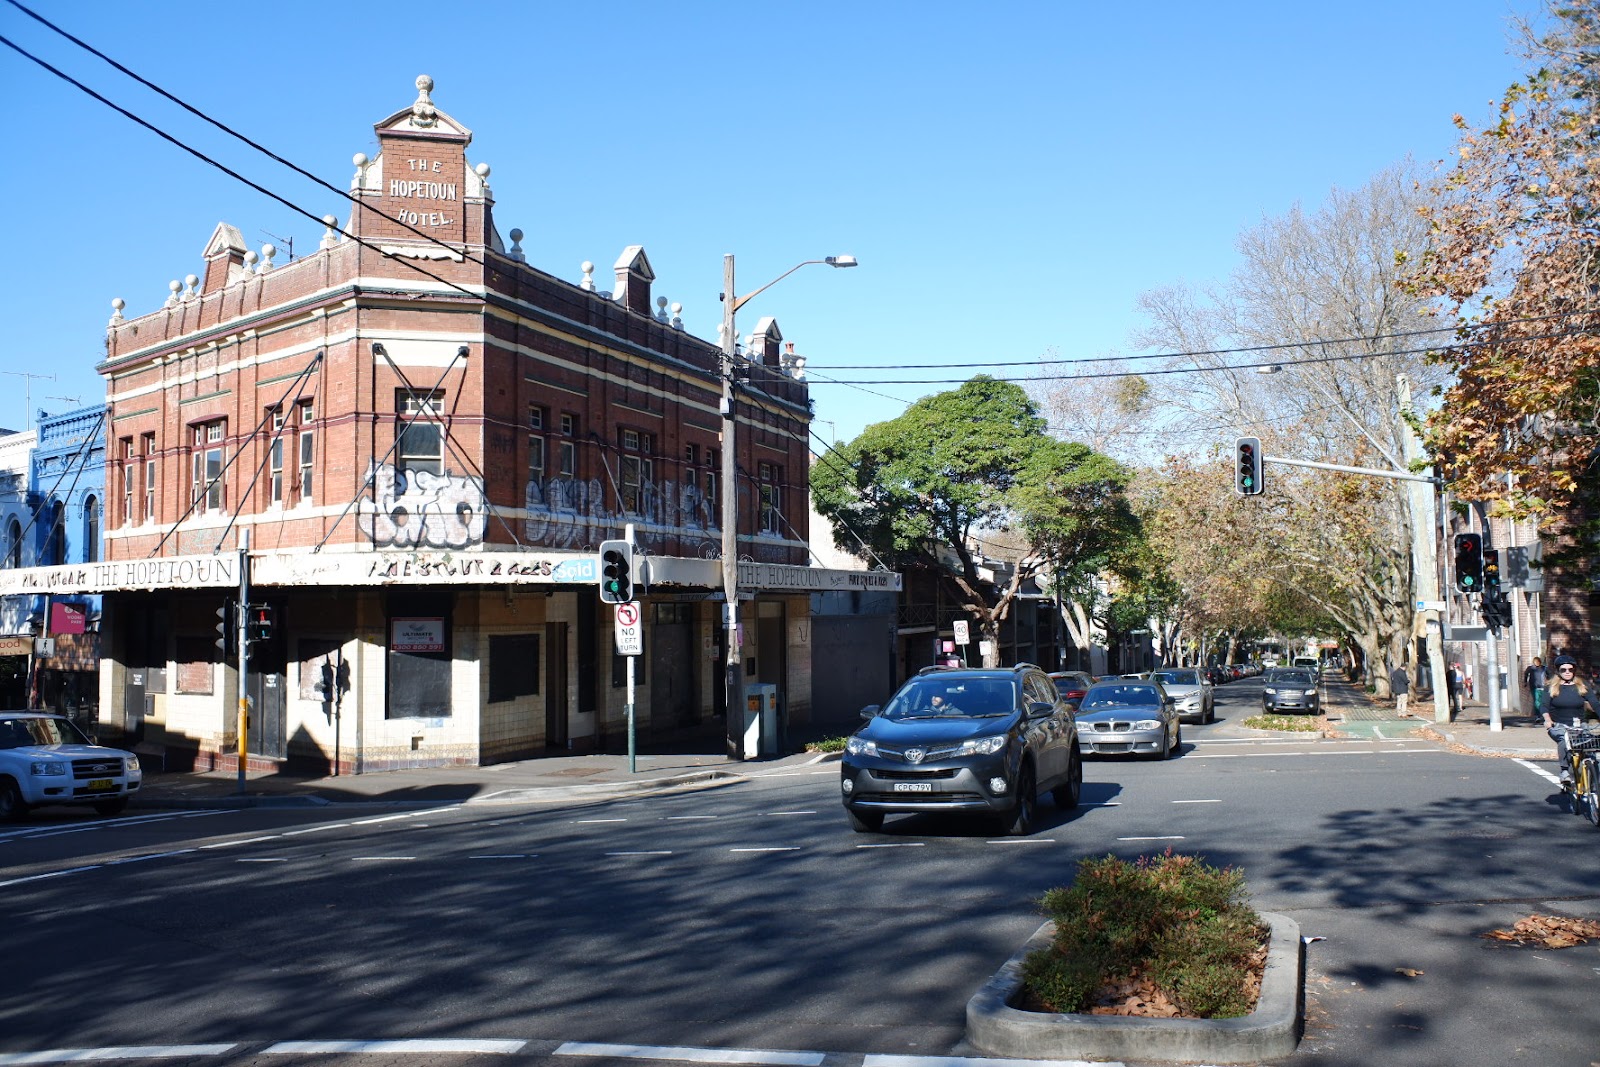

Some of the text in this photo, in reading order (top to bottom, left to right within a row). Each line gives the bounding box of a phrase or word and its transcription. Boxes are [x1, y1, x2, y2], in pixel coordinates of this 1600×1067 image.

[407, 159, 443, 173] THE
[390, 179, 457, 200] HOPETOUN
[93, 564, 119, 587] THE
[126, 558, 233, 586] HOPETOUN
[557, 560, 593, 579] Sold
[738, 565, 761, 585] THE
[768, 565, 822, 587] HOPETOUN
[621, 627, 635, 636] NO
